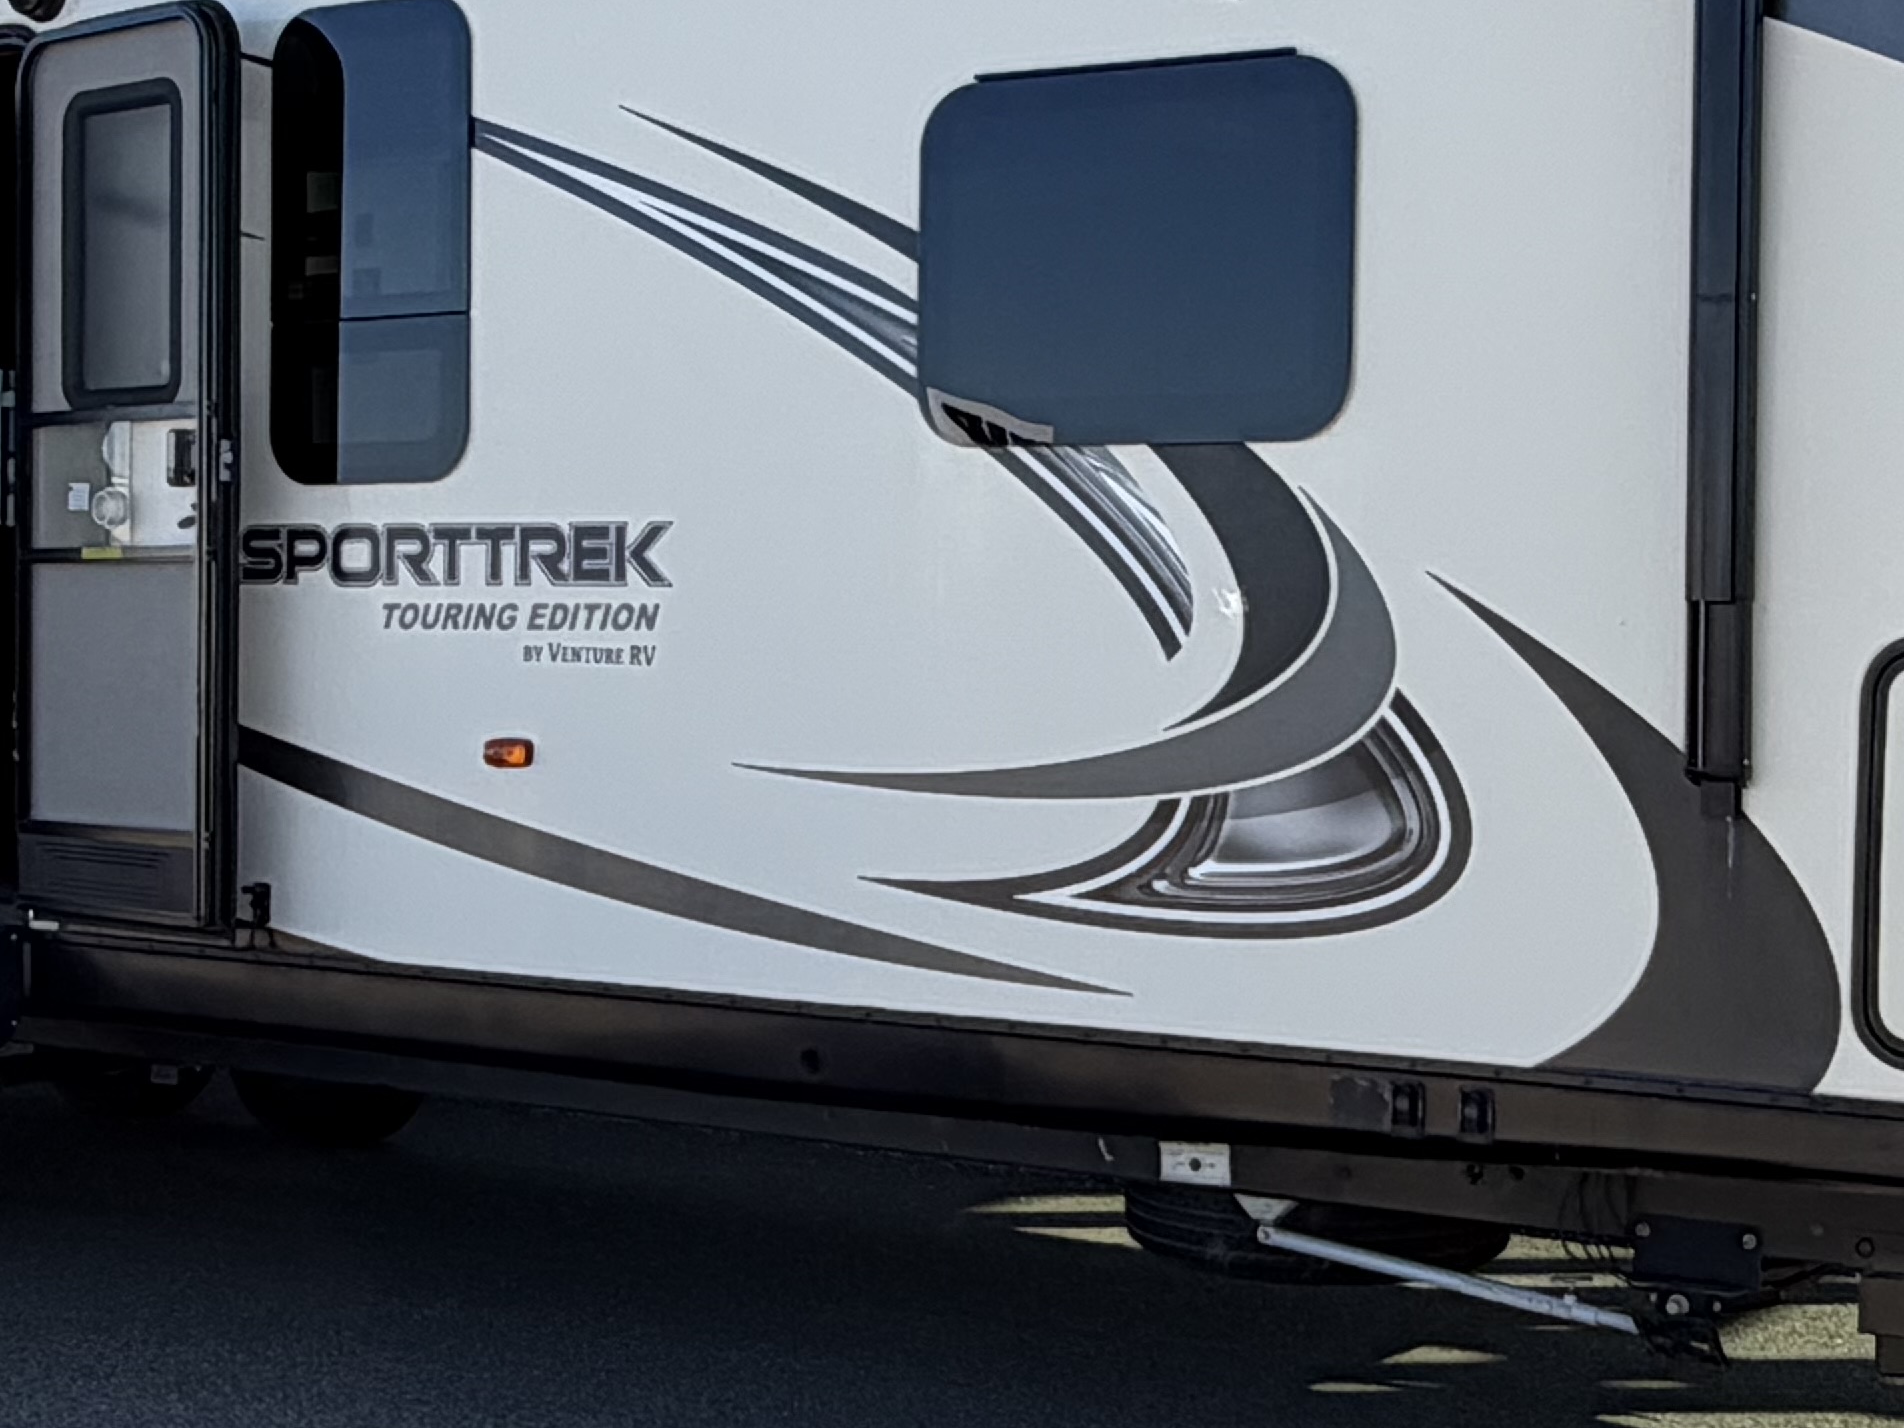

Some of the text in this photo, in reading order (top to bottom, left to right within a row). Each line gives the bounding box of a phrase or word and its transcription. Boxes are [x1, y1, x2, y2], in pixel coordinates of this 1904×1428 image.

[239, 521, 674, 588] SPORTTREK
[382, 602, 661, 633] TOURING EDITION
[628, 644, 657, 667] RV
